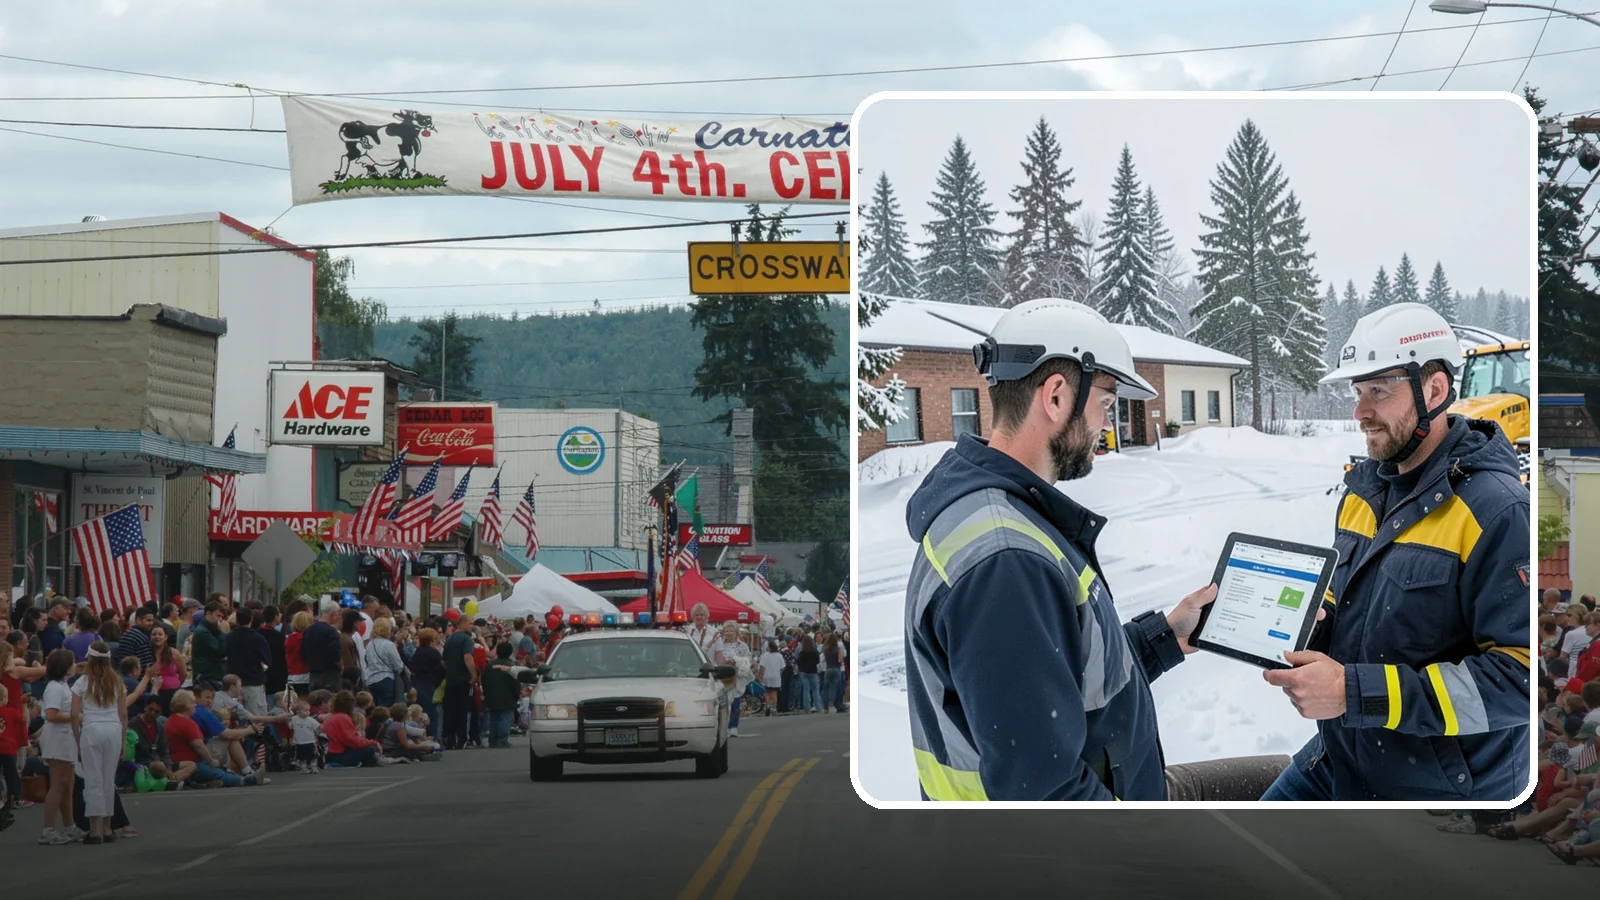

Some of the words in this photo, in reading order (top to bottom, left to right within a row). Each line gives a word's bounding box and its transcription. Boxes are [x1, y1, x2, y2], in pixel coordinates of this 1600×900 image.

[694, 121, 850, 150] Carnat
[481, 141, 605, 192] JULY
[632, 150, 746, 198] 4th.
[697, 254, 850, 280] CROSSWA
[283, 380, 374, 420] ACE
[405, 409, 453, 422] CEDAR
[284, 421, 371, 437] Hardware
[416, 428, 477, 447] Coca-Cola
[353, 466, 385, 481] Simpl
[83, 485, 94, 494] St.
[96, 485, 124, 495] Vincent
[126, 486, 136, 495] de
[137, 486, 155, 495] Paul
[688, 527, 741, 535] CRNATION
[699, 535, 730, 543] GLASS
